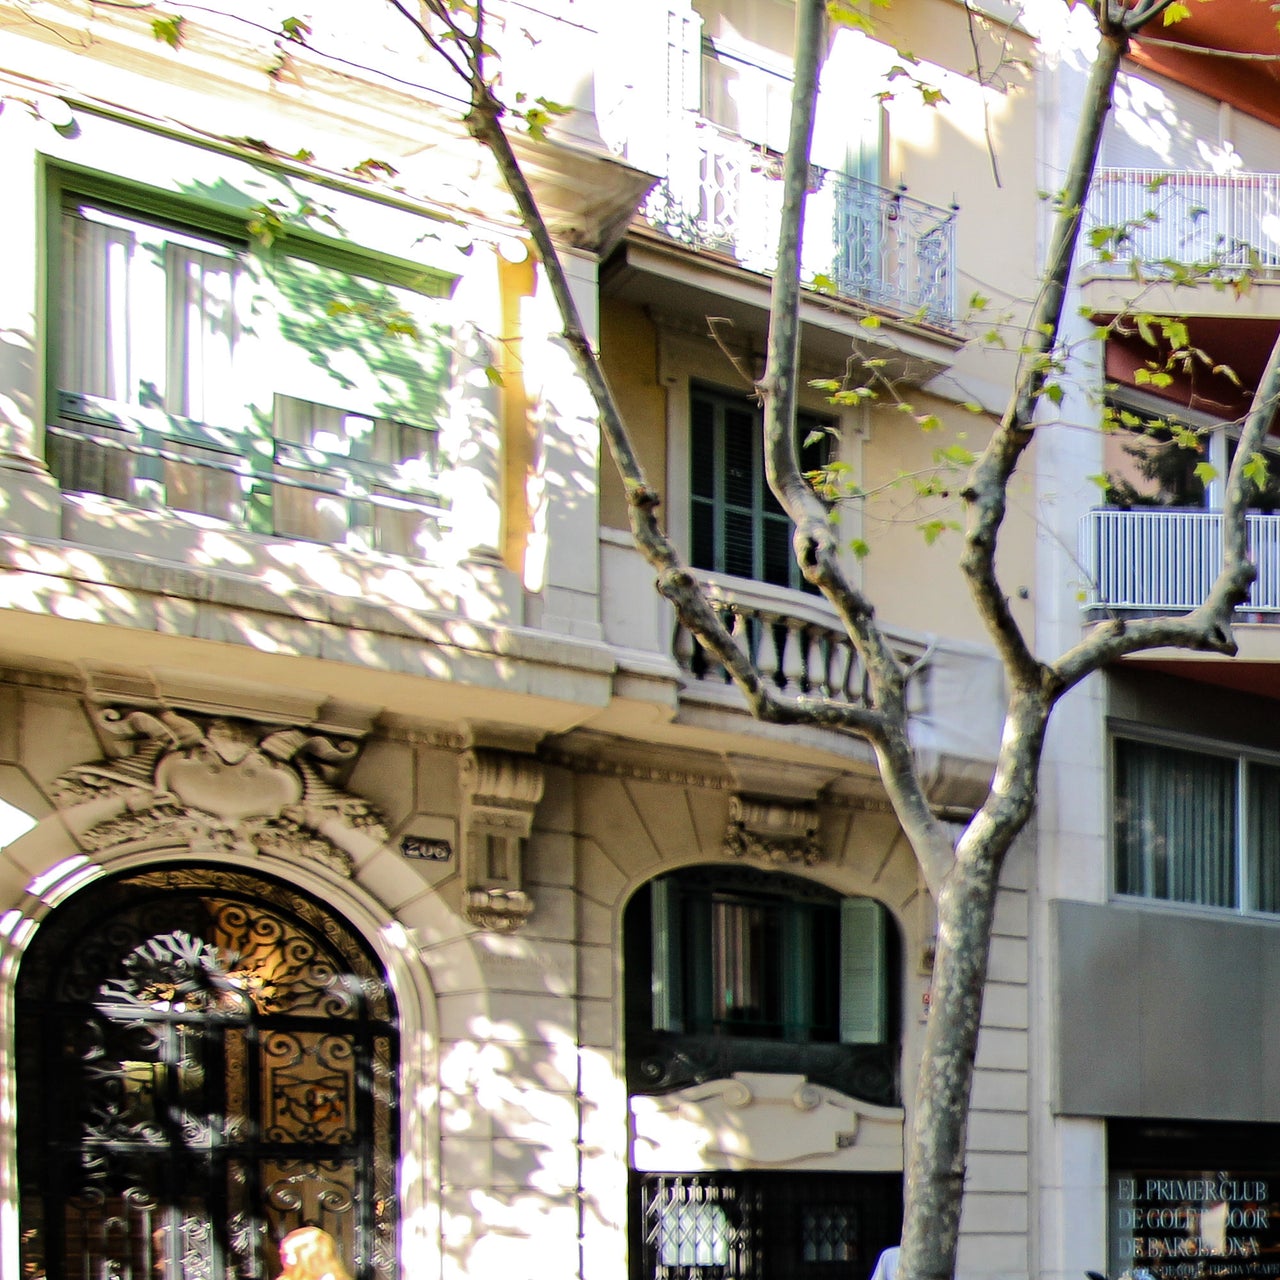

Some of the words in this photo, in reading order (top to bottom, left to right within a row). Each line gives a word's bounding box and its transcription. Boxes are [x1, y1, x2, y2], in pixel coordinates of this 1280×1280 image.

[1118, 1179, 1142, 1201] EL
[1146, 1179, 1216, 1201] PRIMER
[1219, 1180, 1269, 1201] CLUB
[1118, 1208, 1144, 1230] DE
[1118, 1237, 1143, 1258] DE
[1148, 1236, 1260, 1258] BARCEONA
